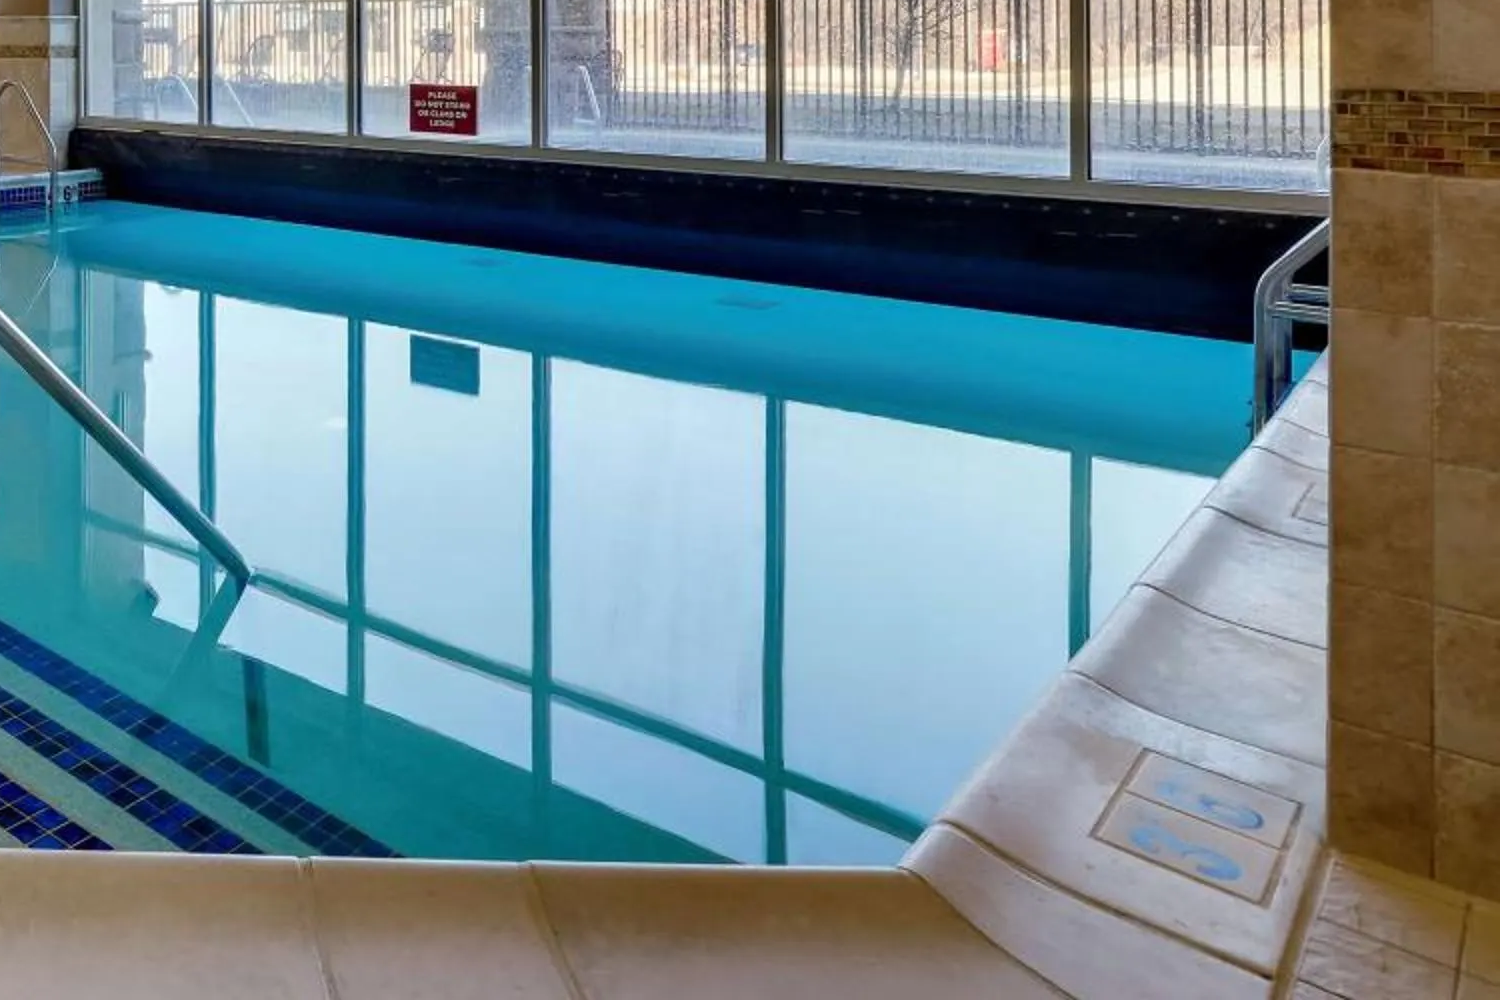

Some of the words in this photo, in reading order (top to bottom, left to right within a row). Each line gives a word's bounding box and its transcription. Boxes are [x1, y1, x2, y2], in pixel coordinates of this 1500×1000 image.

[428, 91, 457, 100] PLEASE
[415, 100, 426, 109] DO
[428, 101, 443, 109] NOT
[444, 101, 471, 110] STAND
